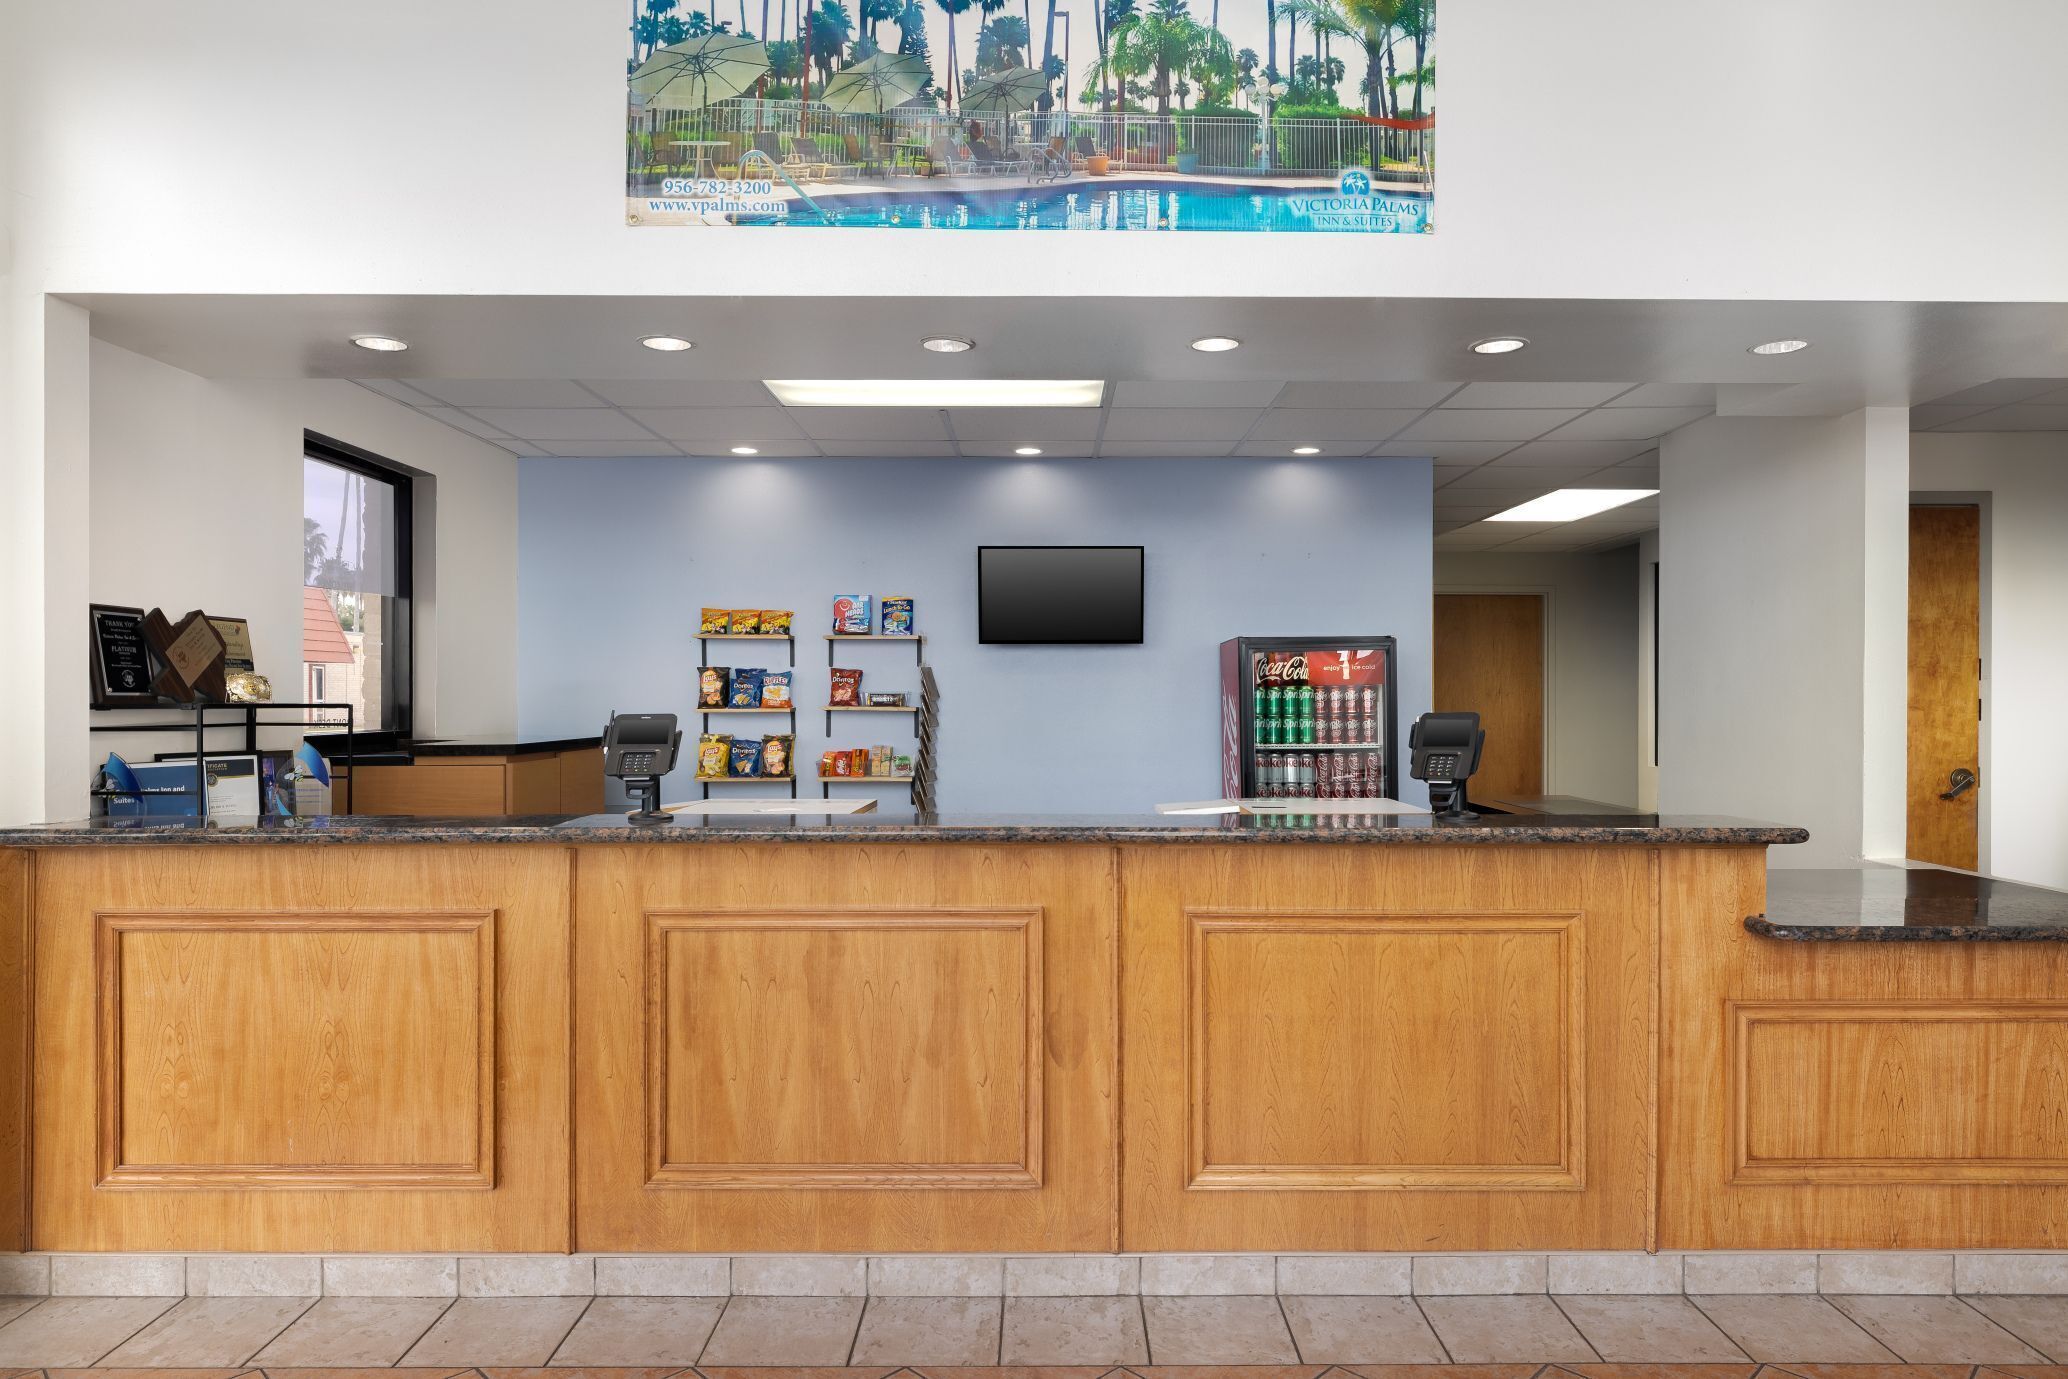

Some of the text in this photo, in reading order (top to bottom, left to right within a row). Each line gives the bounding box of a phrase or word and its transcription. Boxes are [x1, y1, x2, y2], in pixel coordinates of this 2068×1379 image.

[664, 180, 771, 195] 956-782-3200
[649, 198, 785, 215] www.vpalms.com
[1292, 197, 1419, 216] VICTORIA PALMS
[1317, 215, 1392, 227] INN & SUITES
[1257, 656, 1310, 684] Coca-Cola
[833, 676, 855, 684] Doritos
[113, 797, 135, 805] Suites
